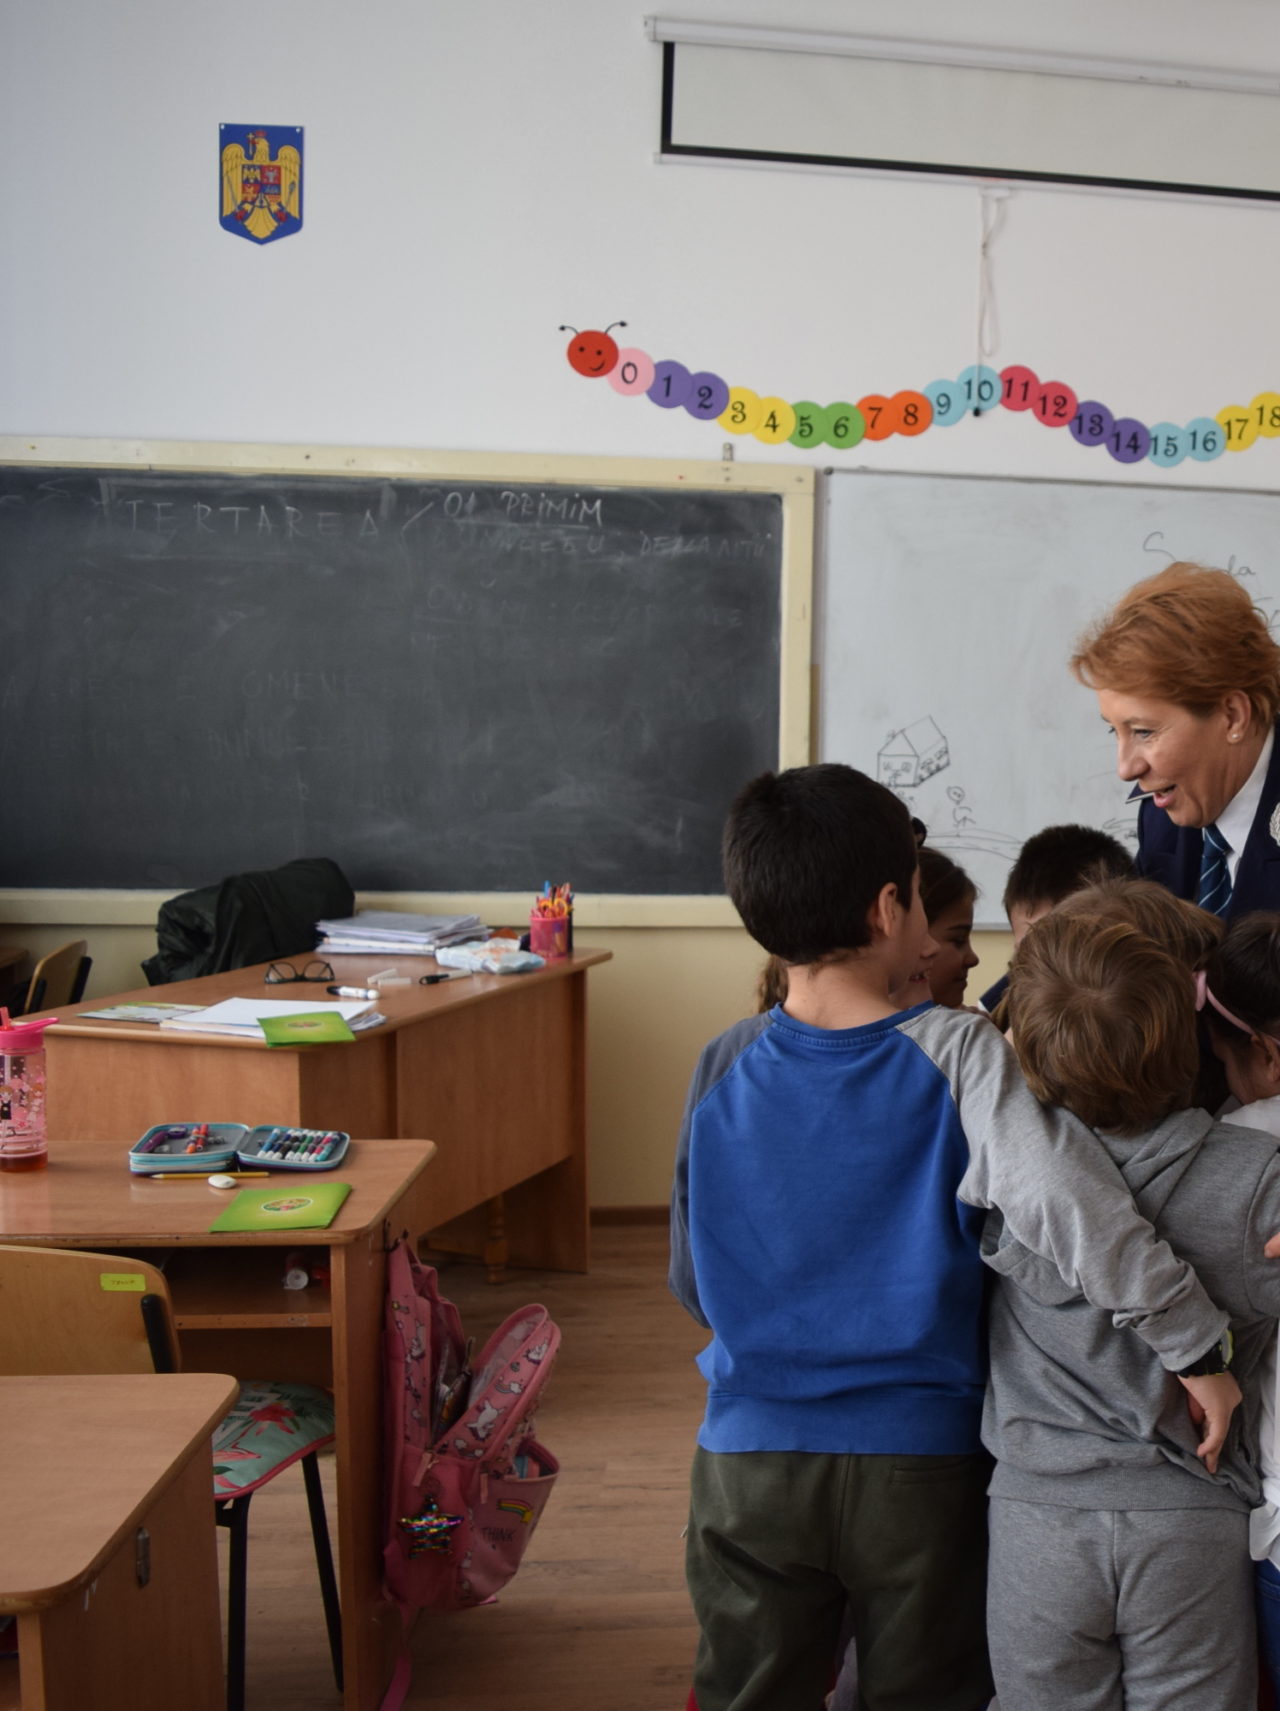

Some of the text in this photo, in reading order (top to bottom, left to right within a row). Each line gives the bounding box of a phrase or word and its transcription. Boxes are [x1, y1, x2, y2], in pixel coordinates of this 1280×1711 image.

[622, 364, 638, 383] 0
[663, 376, 672, 396] 1
[697, 387, 714, 407] 2
[732, 401, 746, 423] 3
[764, 411, 780, 433] 4
[799, 415, 813, 438] 5
[834, 416, 850, 438] 6
[868, 407, 883, 430] 7
[904, 404, 918, 426] 8
[937, 393, 951, 415] 9
[965, 380, 994, 400] 10
[1004, 377, 1031, 401] 11
[1039, 393, 1068, 416] 12
[1074, 414, 1104, 437] 13
[1113, 431, 1141, 454] 14
[1151, 436, 1178, 457] 15
[1189, 430, 1216, 452] 16
[1224, 419, 1249, 440] 17
